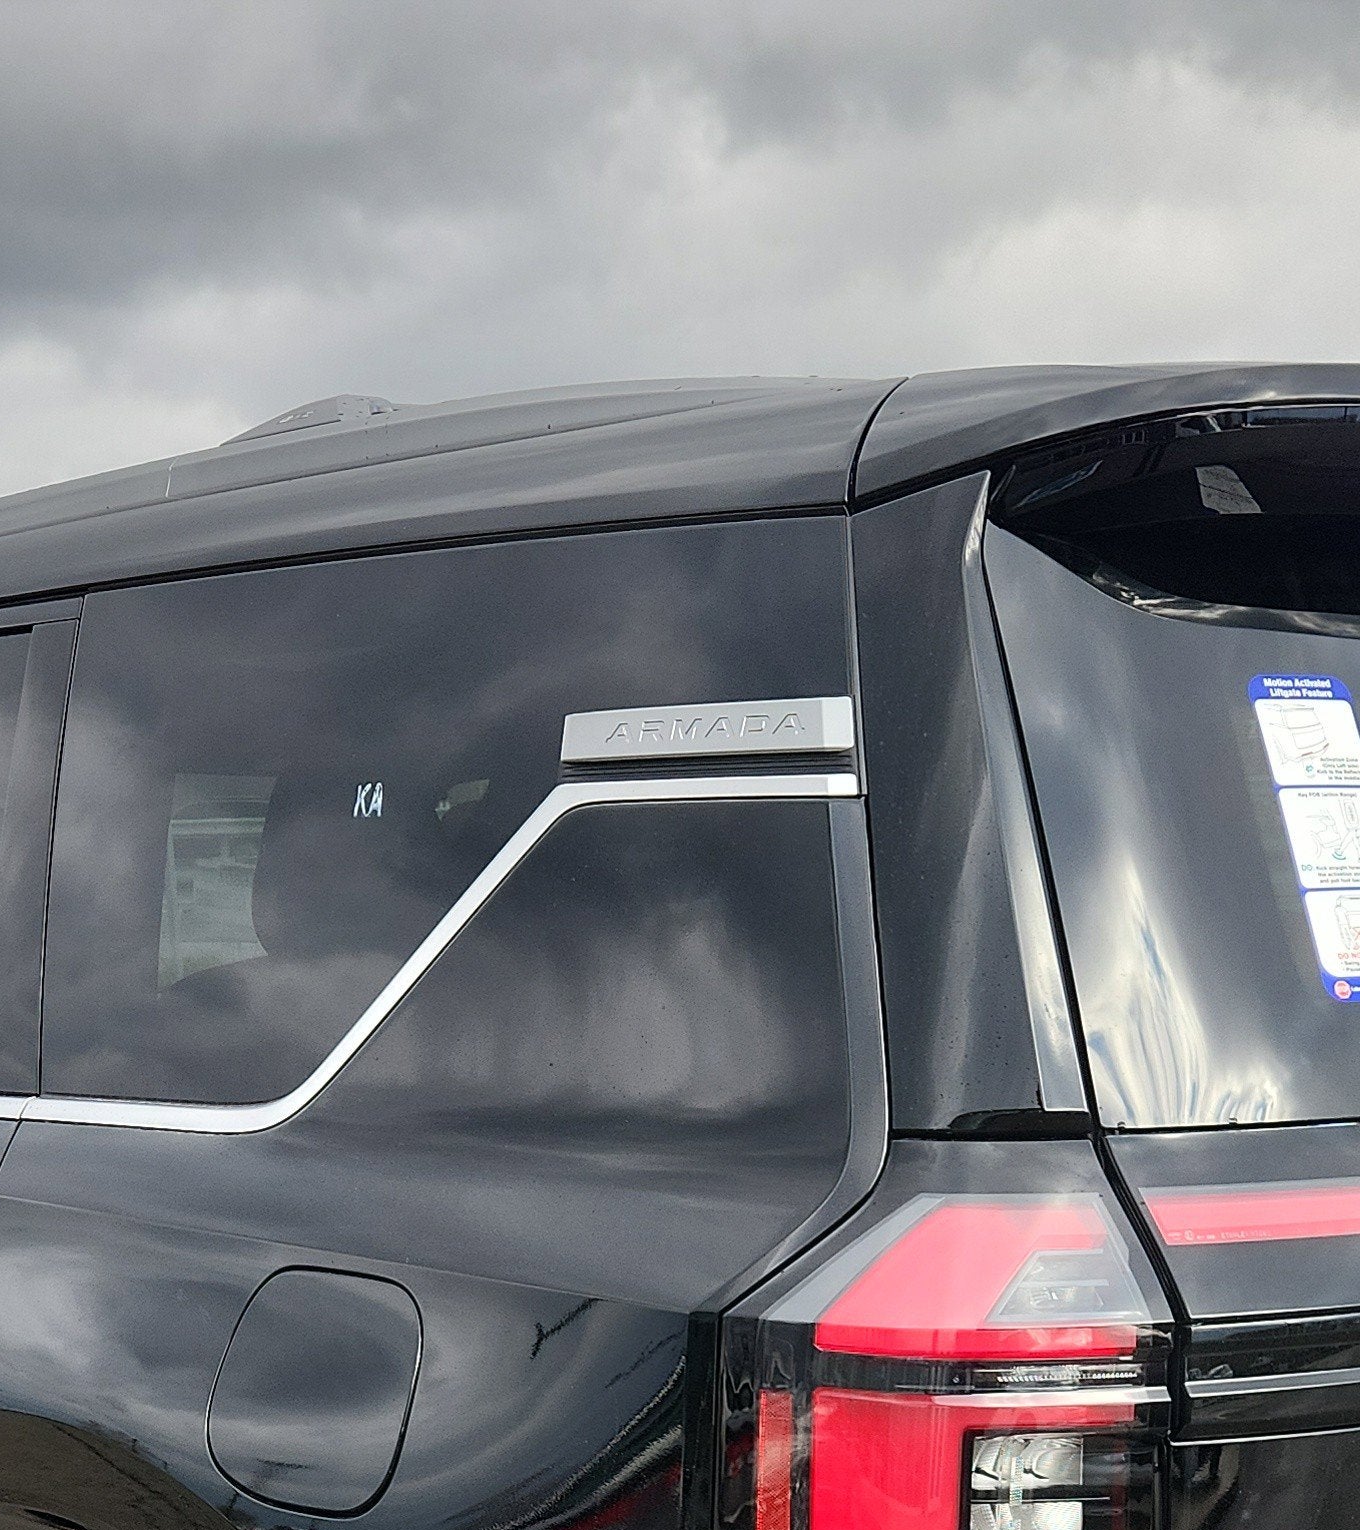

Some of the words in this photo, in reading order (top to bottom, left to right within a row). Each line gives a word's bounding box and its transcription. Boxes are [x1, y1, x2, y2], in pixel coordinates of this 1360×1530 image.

[1263, 678, 1293, 687] Motion
[1294, 679, 1331, 688] Activated
[1269, 688, 1301, 698] Liftgate
[1302, 689, 1333, 698] Feature
[605, 712, 806, 744] ARMADA
